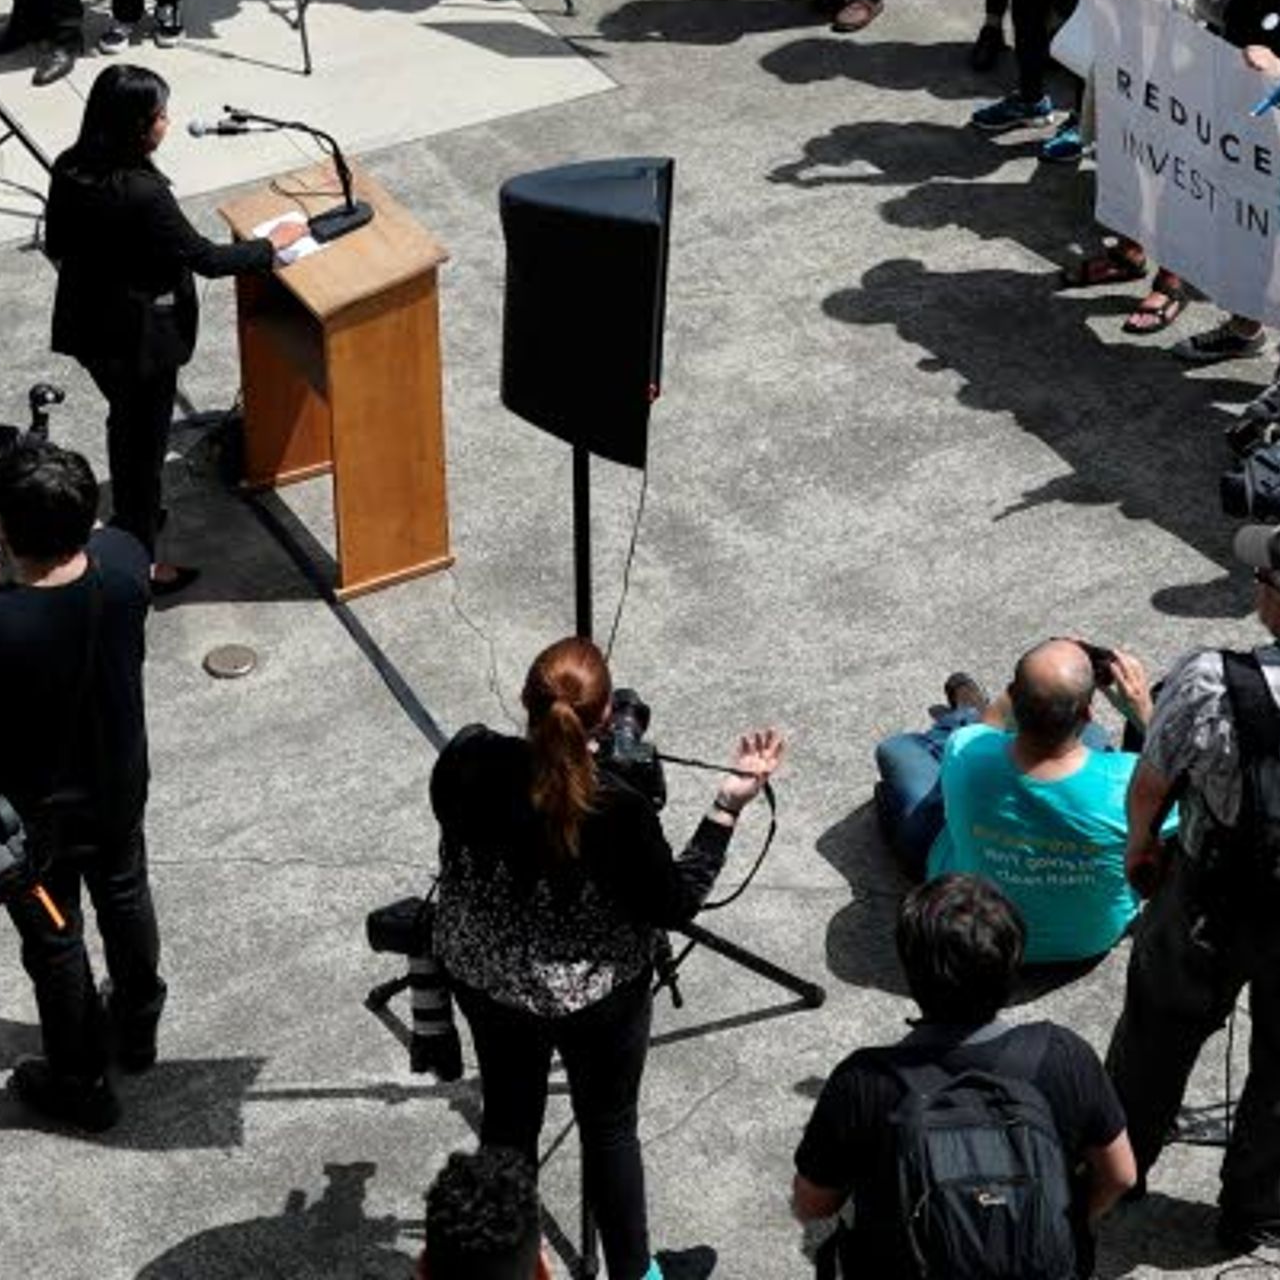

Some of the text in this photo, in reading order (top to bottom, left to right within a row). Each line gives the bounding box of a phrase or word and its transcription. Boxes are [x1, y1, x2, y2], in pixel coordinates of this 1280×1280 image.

[1116, 68, 1273, 176] REDUCE
[1123, 129, 1269, 238] INVEST IN
